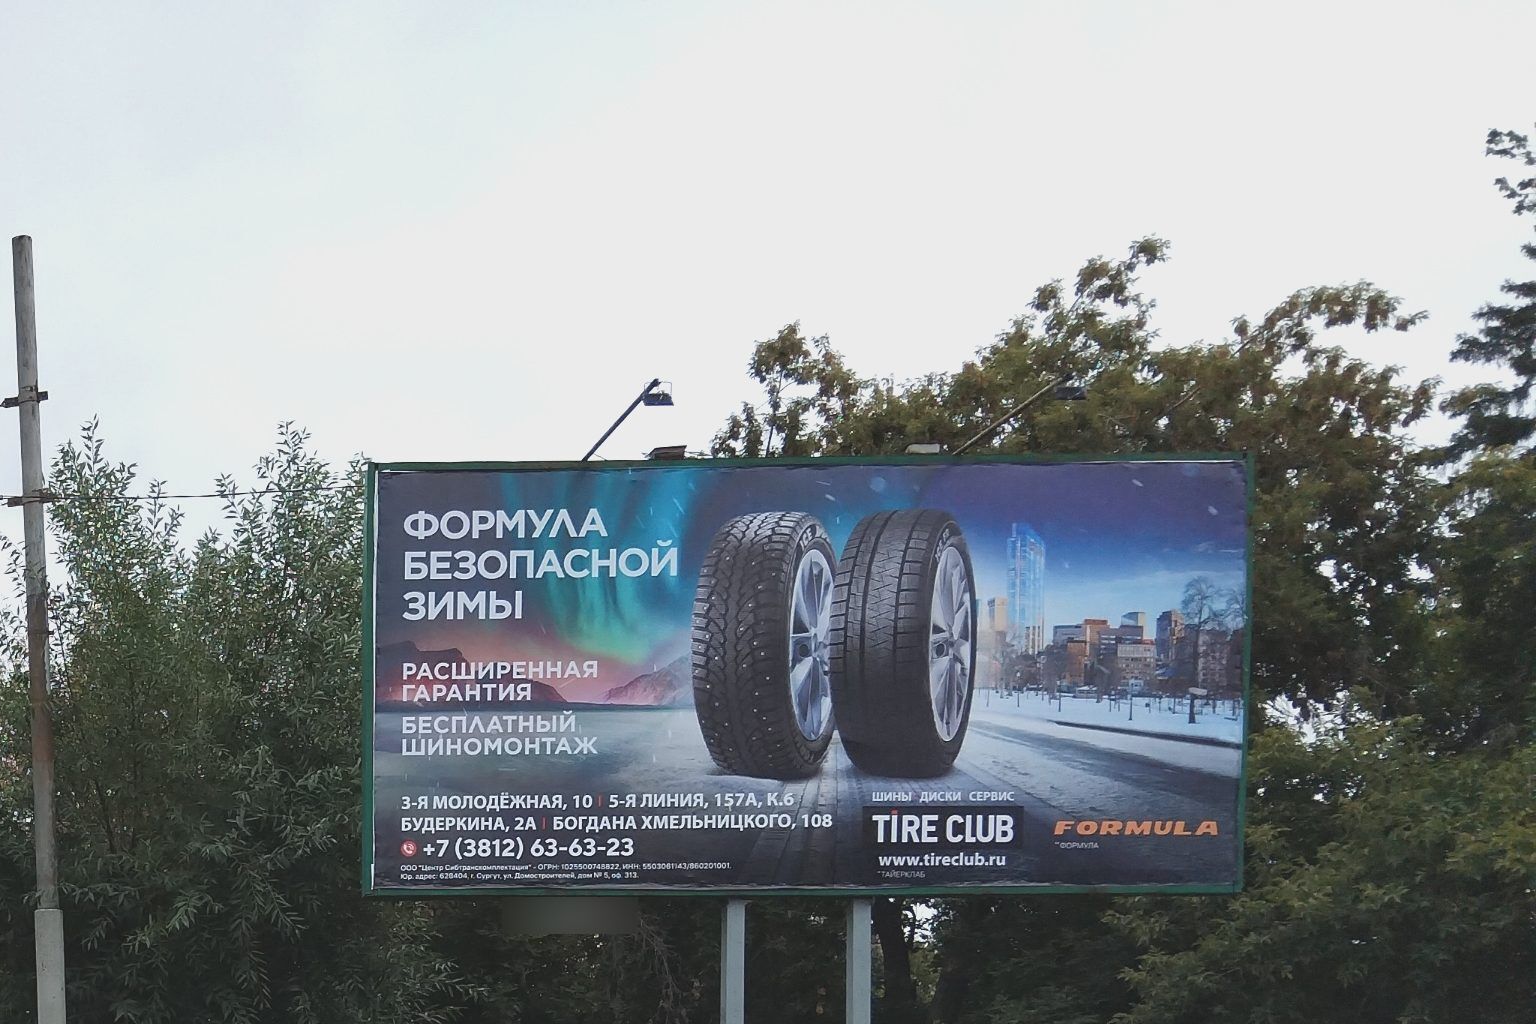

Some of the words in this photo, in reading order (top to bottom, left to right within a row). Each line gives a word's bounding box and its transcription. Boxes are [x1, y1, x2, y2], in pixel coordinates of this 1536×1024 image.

[403, 508, 608, 540] ФОРМУЛА
[404, 539, 678, 580] БЕЗОПАСНОЙ
[402, 590, 523, 621] ЗИМЫ
[401, 660, 599, 680] РАСШИРЕННАЯ
[401, 683, 532, 702] ГАРАНТИЯ
[401, 710, 577, 734] БЕСПЛАТНЫЙ
[401, 736, 598, 756] ШИНОМОНТАЖ
[401, 796, 428, 810] 3-Я
[432, 792, 568, 812] МОЛОДЁЖНАЯ,
[572, 795, 593, 809] 10
[608, 794, 636, 808] 5-Я
[640, 793, 709, 809] ЛИНИЯ,
[715, 793, 763, 809] 157А,
[872, 791, 912, 802] ШИНЫ
[919, 791, 962, 803] ДИСКИ
[968, 791, 1015, 801] СЕРВИС
[401, 817, 510, 834] БУДЕРКИНА,
[514, 817, 537, 830] 2А
[553, 815, 637, 832] БОГДАНА
[641, 814, 797, 831] ХМЕЛЬНИЦКОГО,
[802, 814, 833, 827] 108
[872, 809, 939, 843] TIRE
[945, 814, 1014, 843] CLUB
[1053, 820, 1219, 836] FORMULA
[423, 839, 450, 857] +7
[454, 836, 524, 860] (3812)
[530, 837, 634, 857] 63-63-23
[878, 852, 1006, 866] www.tireclub.ru
[476, 872, 502, 880] Сургут,
